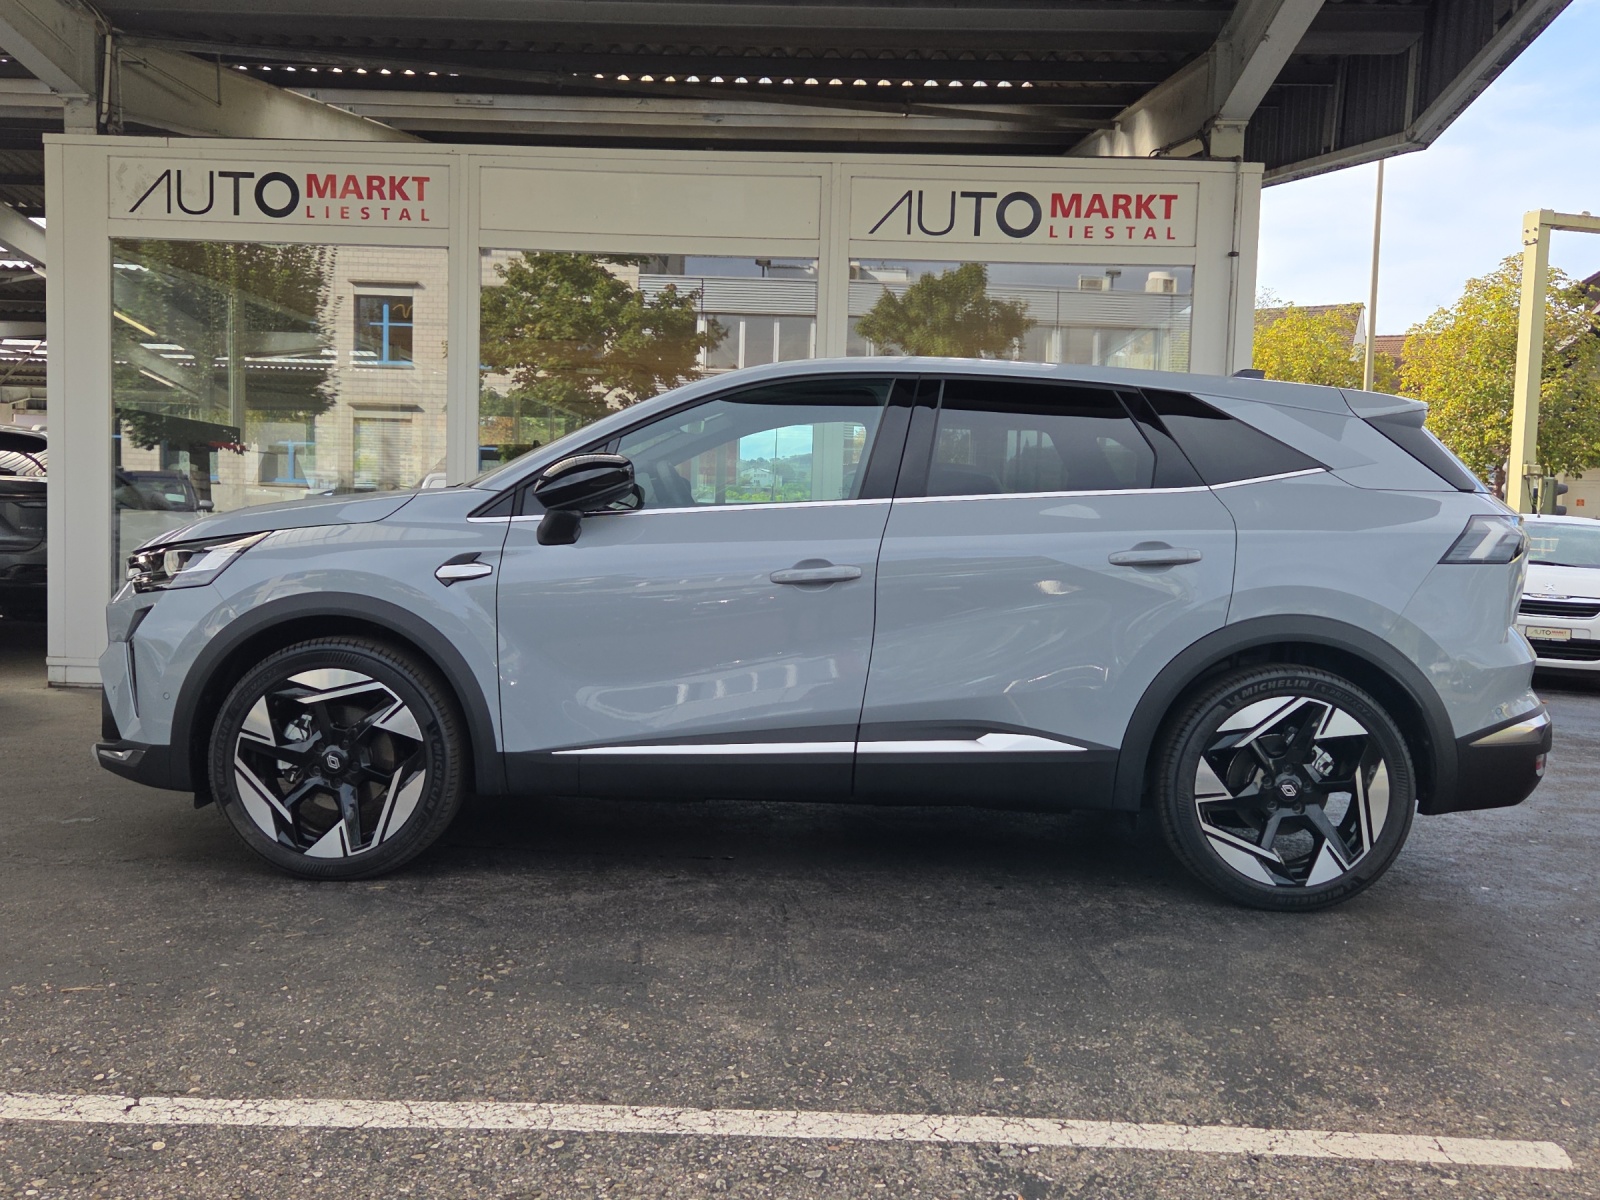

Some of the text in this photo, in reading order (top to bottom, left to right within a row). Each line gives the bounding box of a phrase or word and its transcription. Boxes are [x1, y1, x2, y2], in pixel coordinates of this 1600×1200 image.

[128, 169, 430, 218] AUTO MARKT
[306, 206, 430, 221] LIESTAL
[868, 190, 1178, 238] AUTO MARKT
[1049, 225, 1176, 240] LIESTAL
[1241, 679, 1310, 698] MICHELIN
[1329, 689, 1368, 713] PRIMACY
[215, 717, 233, 785] MICHELIN
[426, 742, 443, 810] MICHELIN
